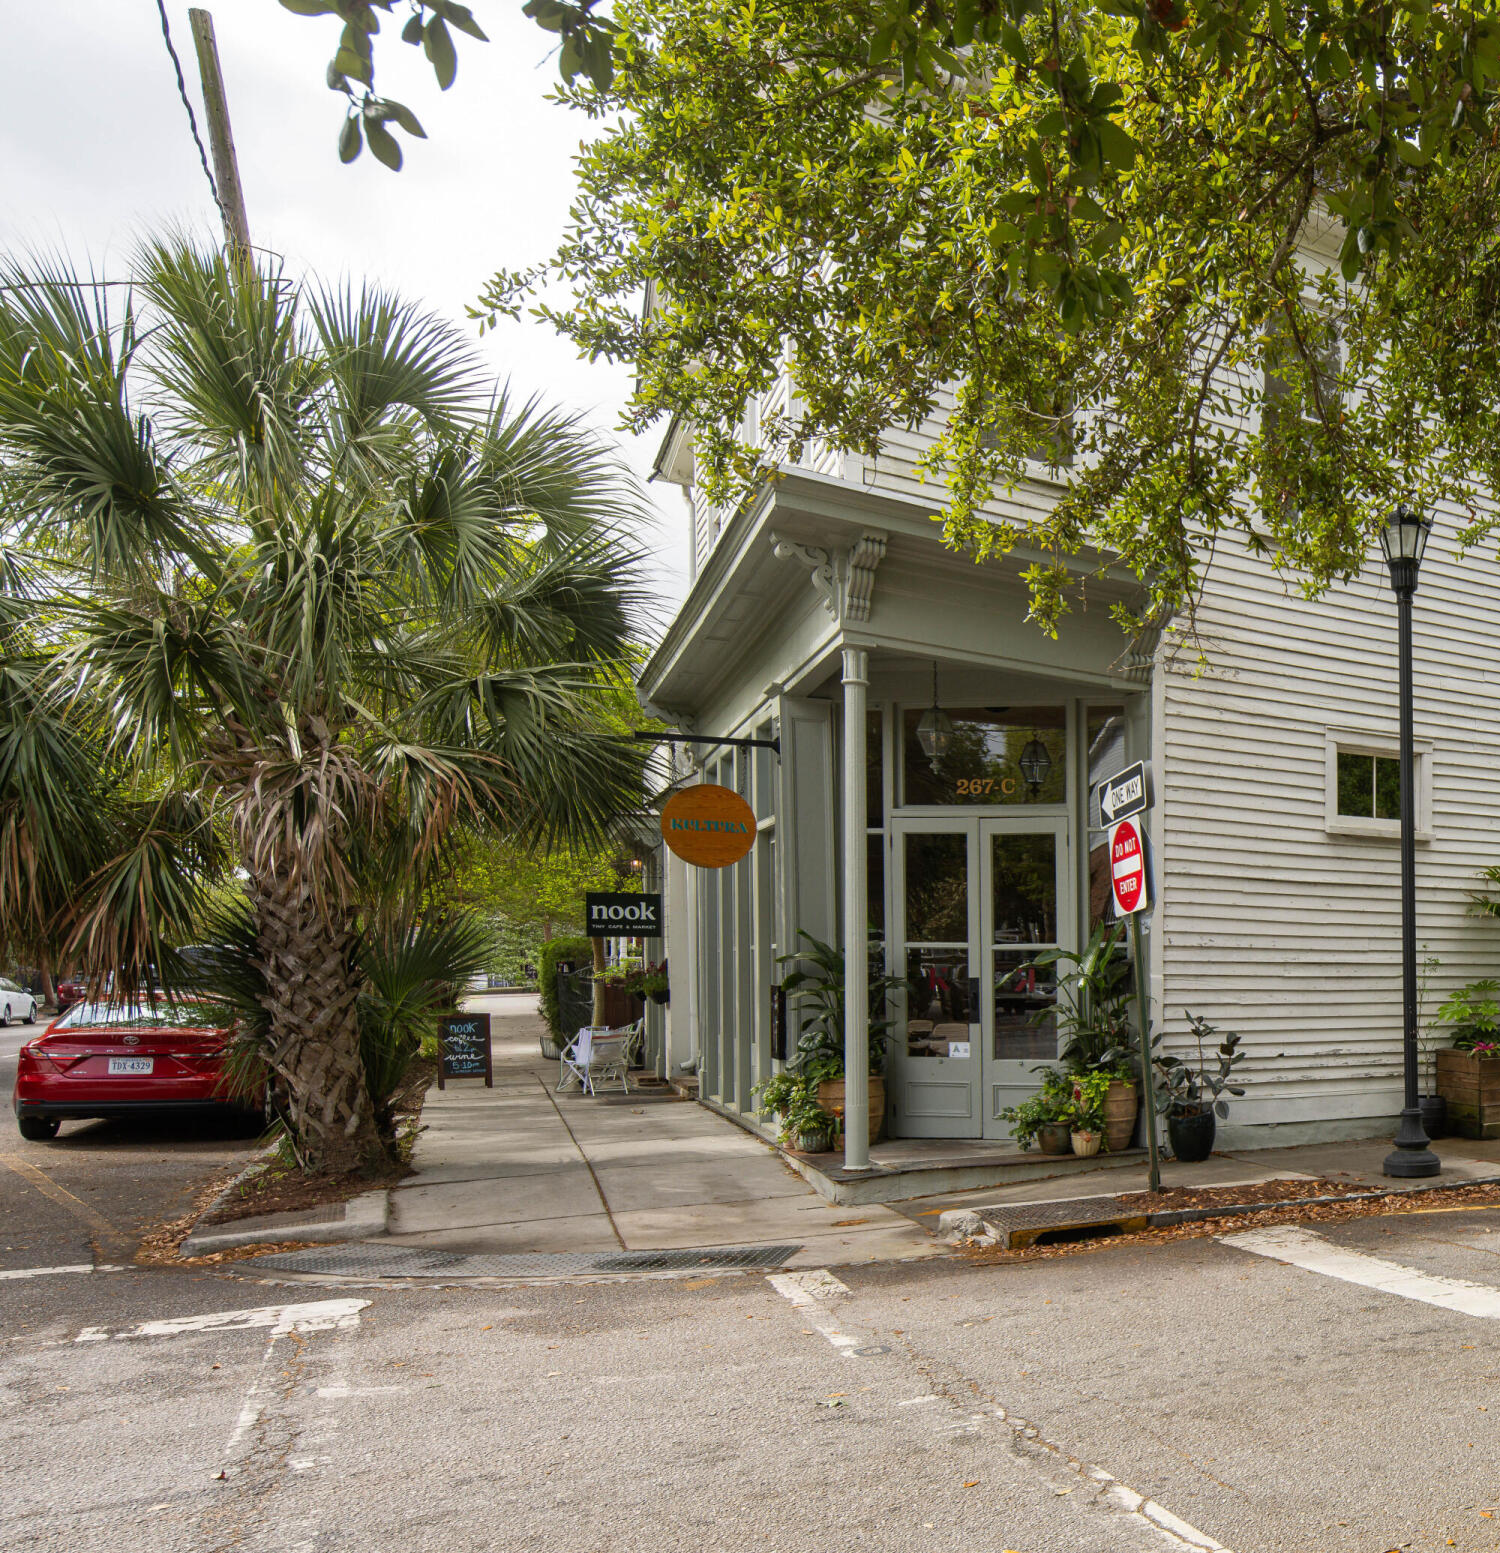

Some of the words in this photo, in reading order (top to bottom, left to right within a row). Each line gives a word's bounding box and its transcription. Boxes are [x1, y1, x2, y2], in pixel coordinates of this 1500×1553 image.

[956, 779, 1017, 795] 267-C
[1111, 787, 1124, 809] ONE
[1125, 778, 1139, 800] WAY
[671, 818, 748, 833] KULTURA
[1115, 844, 1123, 858] DO
[1124, 837, 1136, 854] NOT
[1119, 877, 1138, 895] ENTER
[591, 901, 656, 921] nook
[444, 1034, 485, 1045] coffee
[444, 1053, 485, 1061] wine
[112, 1061, 151, 1071] TDX-4329
